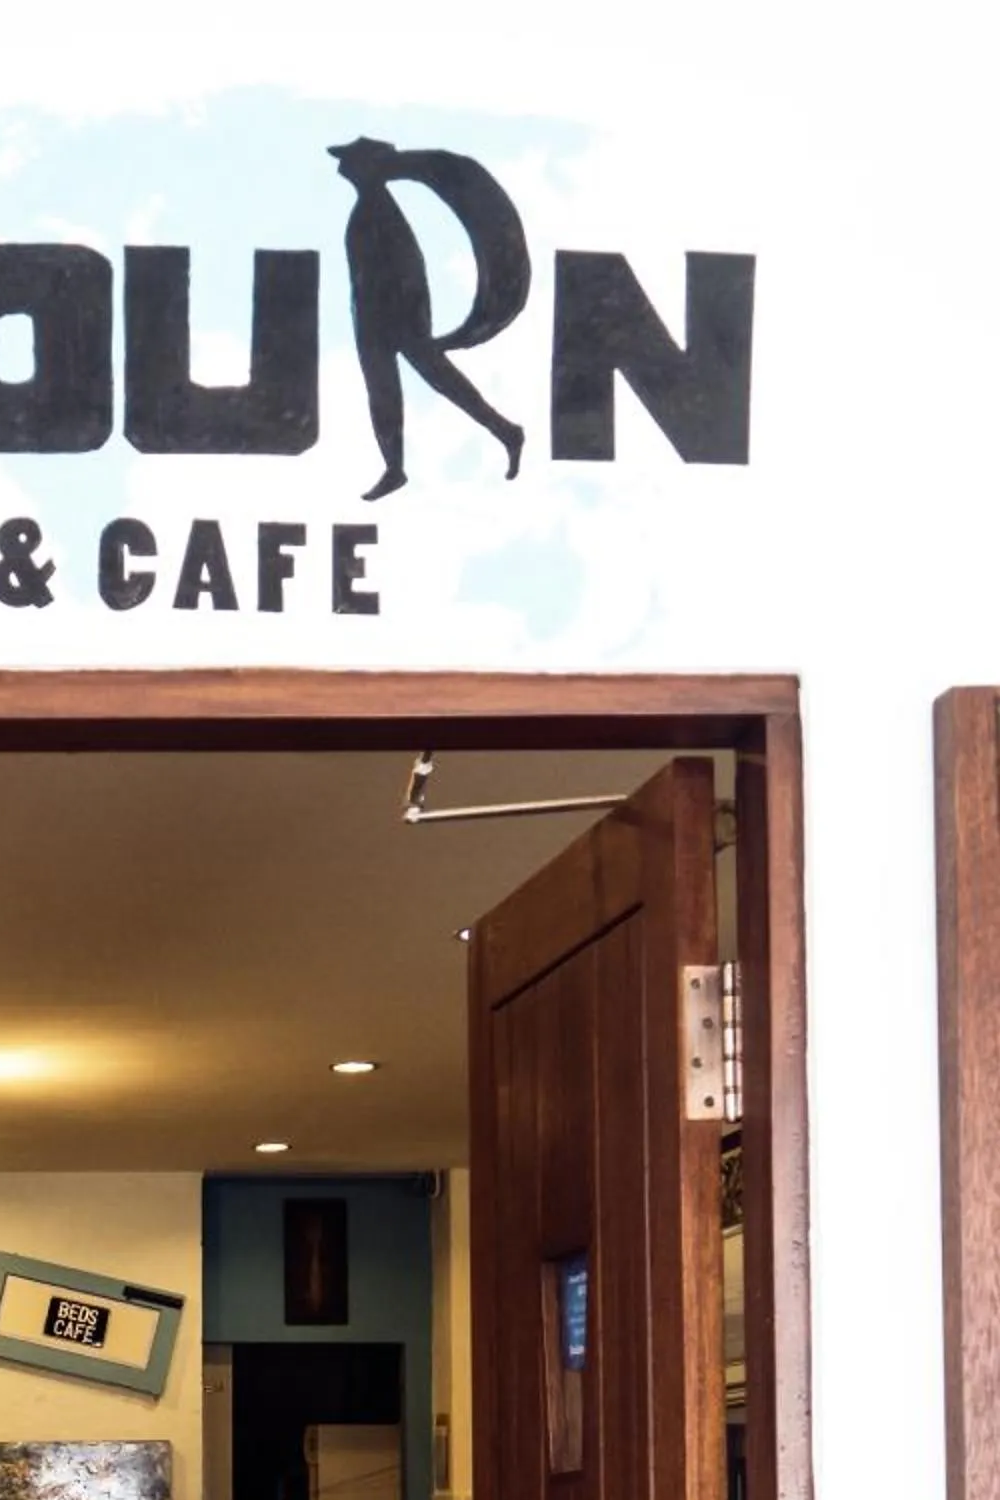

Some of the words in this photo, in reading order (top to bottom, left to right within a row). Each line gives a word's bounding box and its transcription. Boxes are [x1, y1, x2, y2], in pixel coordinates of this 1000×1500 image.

[99, 519, 379, 614] CAFE
[58, 1302, 99, 1325] BEDS
[53, 1320, 96, 1342] CAFE
